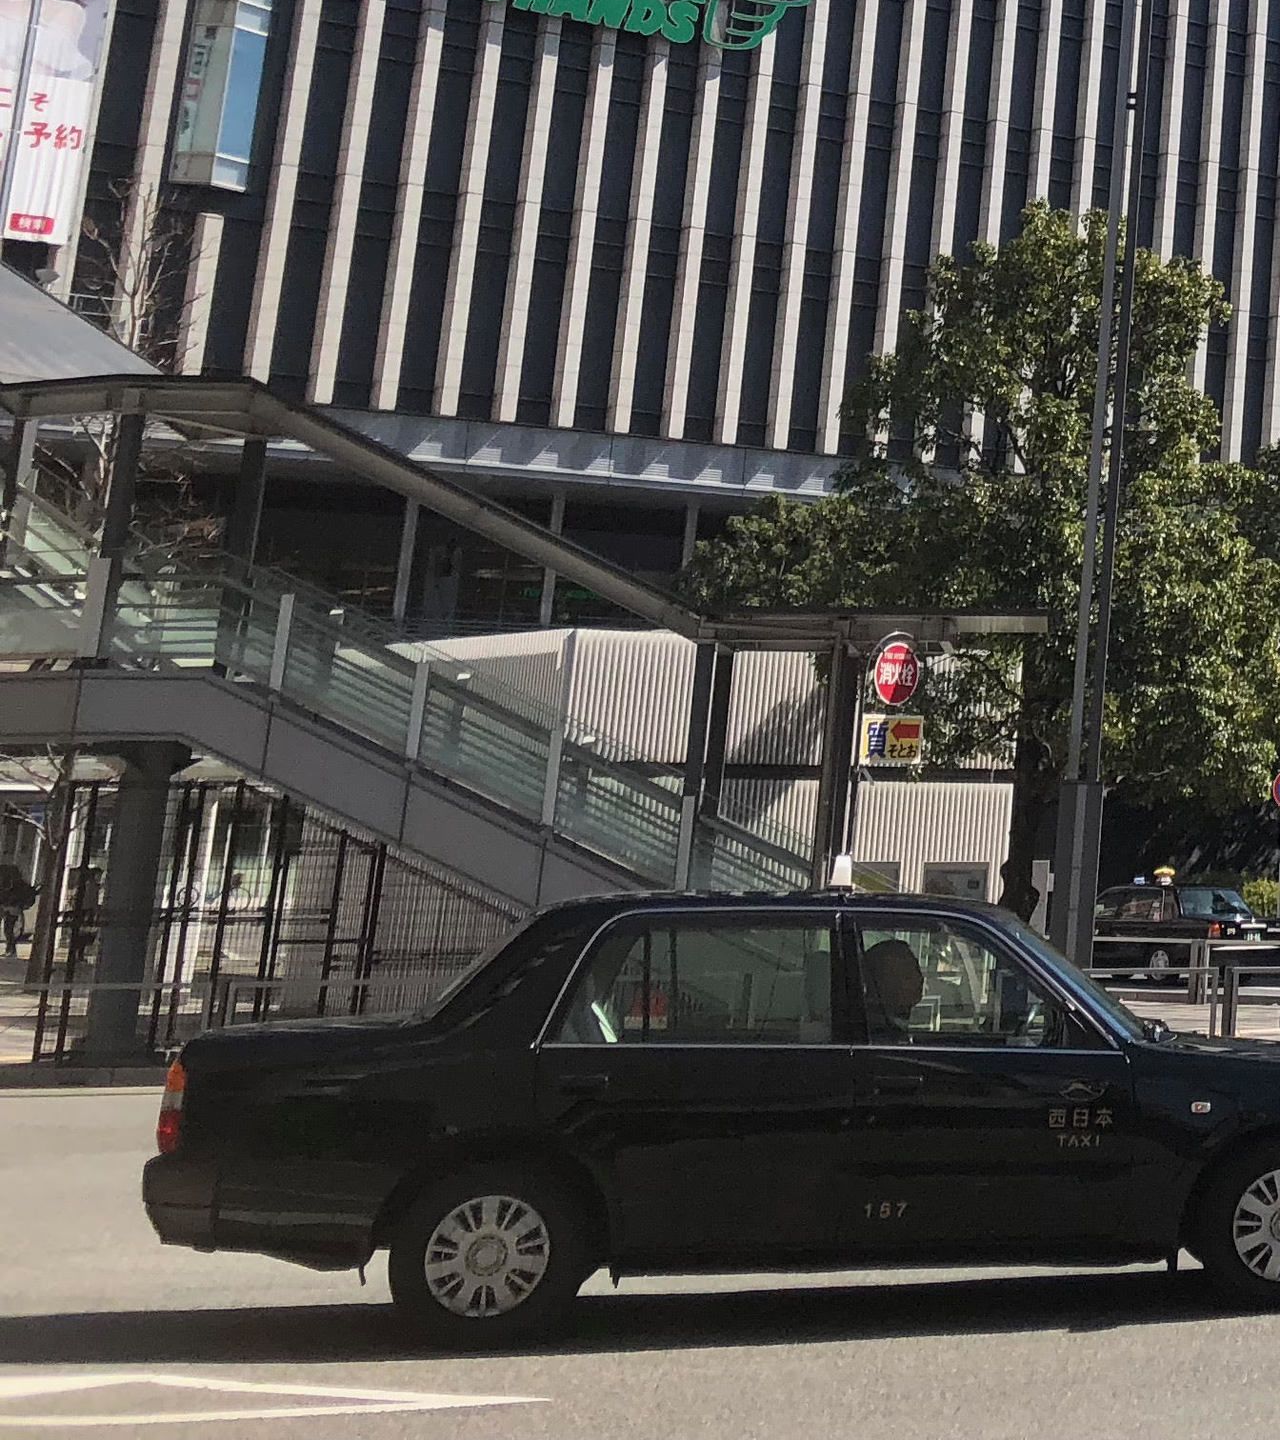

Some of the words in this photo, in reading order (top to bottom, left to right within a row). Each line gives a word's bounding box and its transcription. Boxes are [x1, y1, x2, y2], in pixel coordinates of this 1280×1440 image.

[24, 122, 82, 150] 予約
[879, 662, 914, 687] 消火栓
[866, 721, 889, 758] 質
[1048, 1108, 1113, 1128] 西日本
[1057, 1134, 1101, 1148] TAXI
